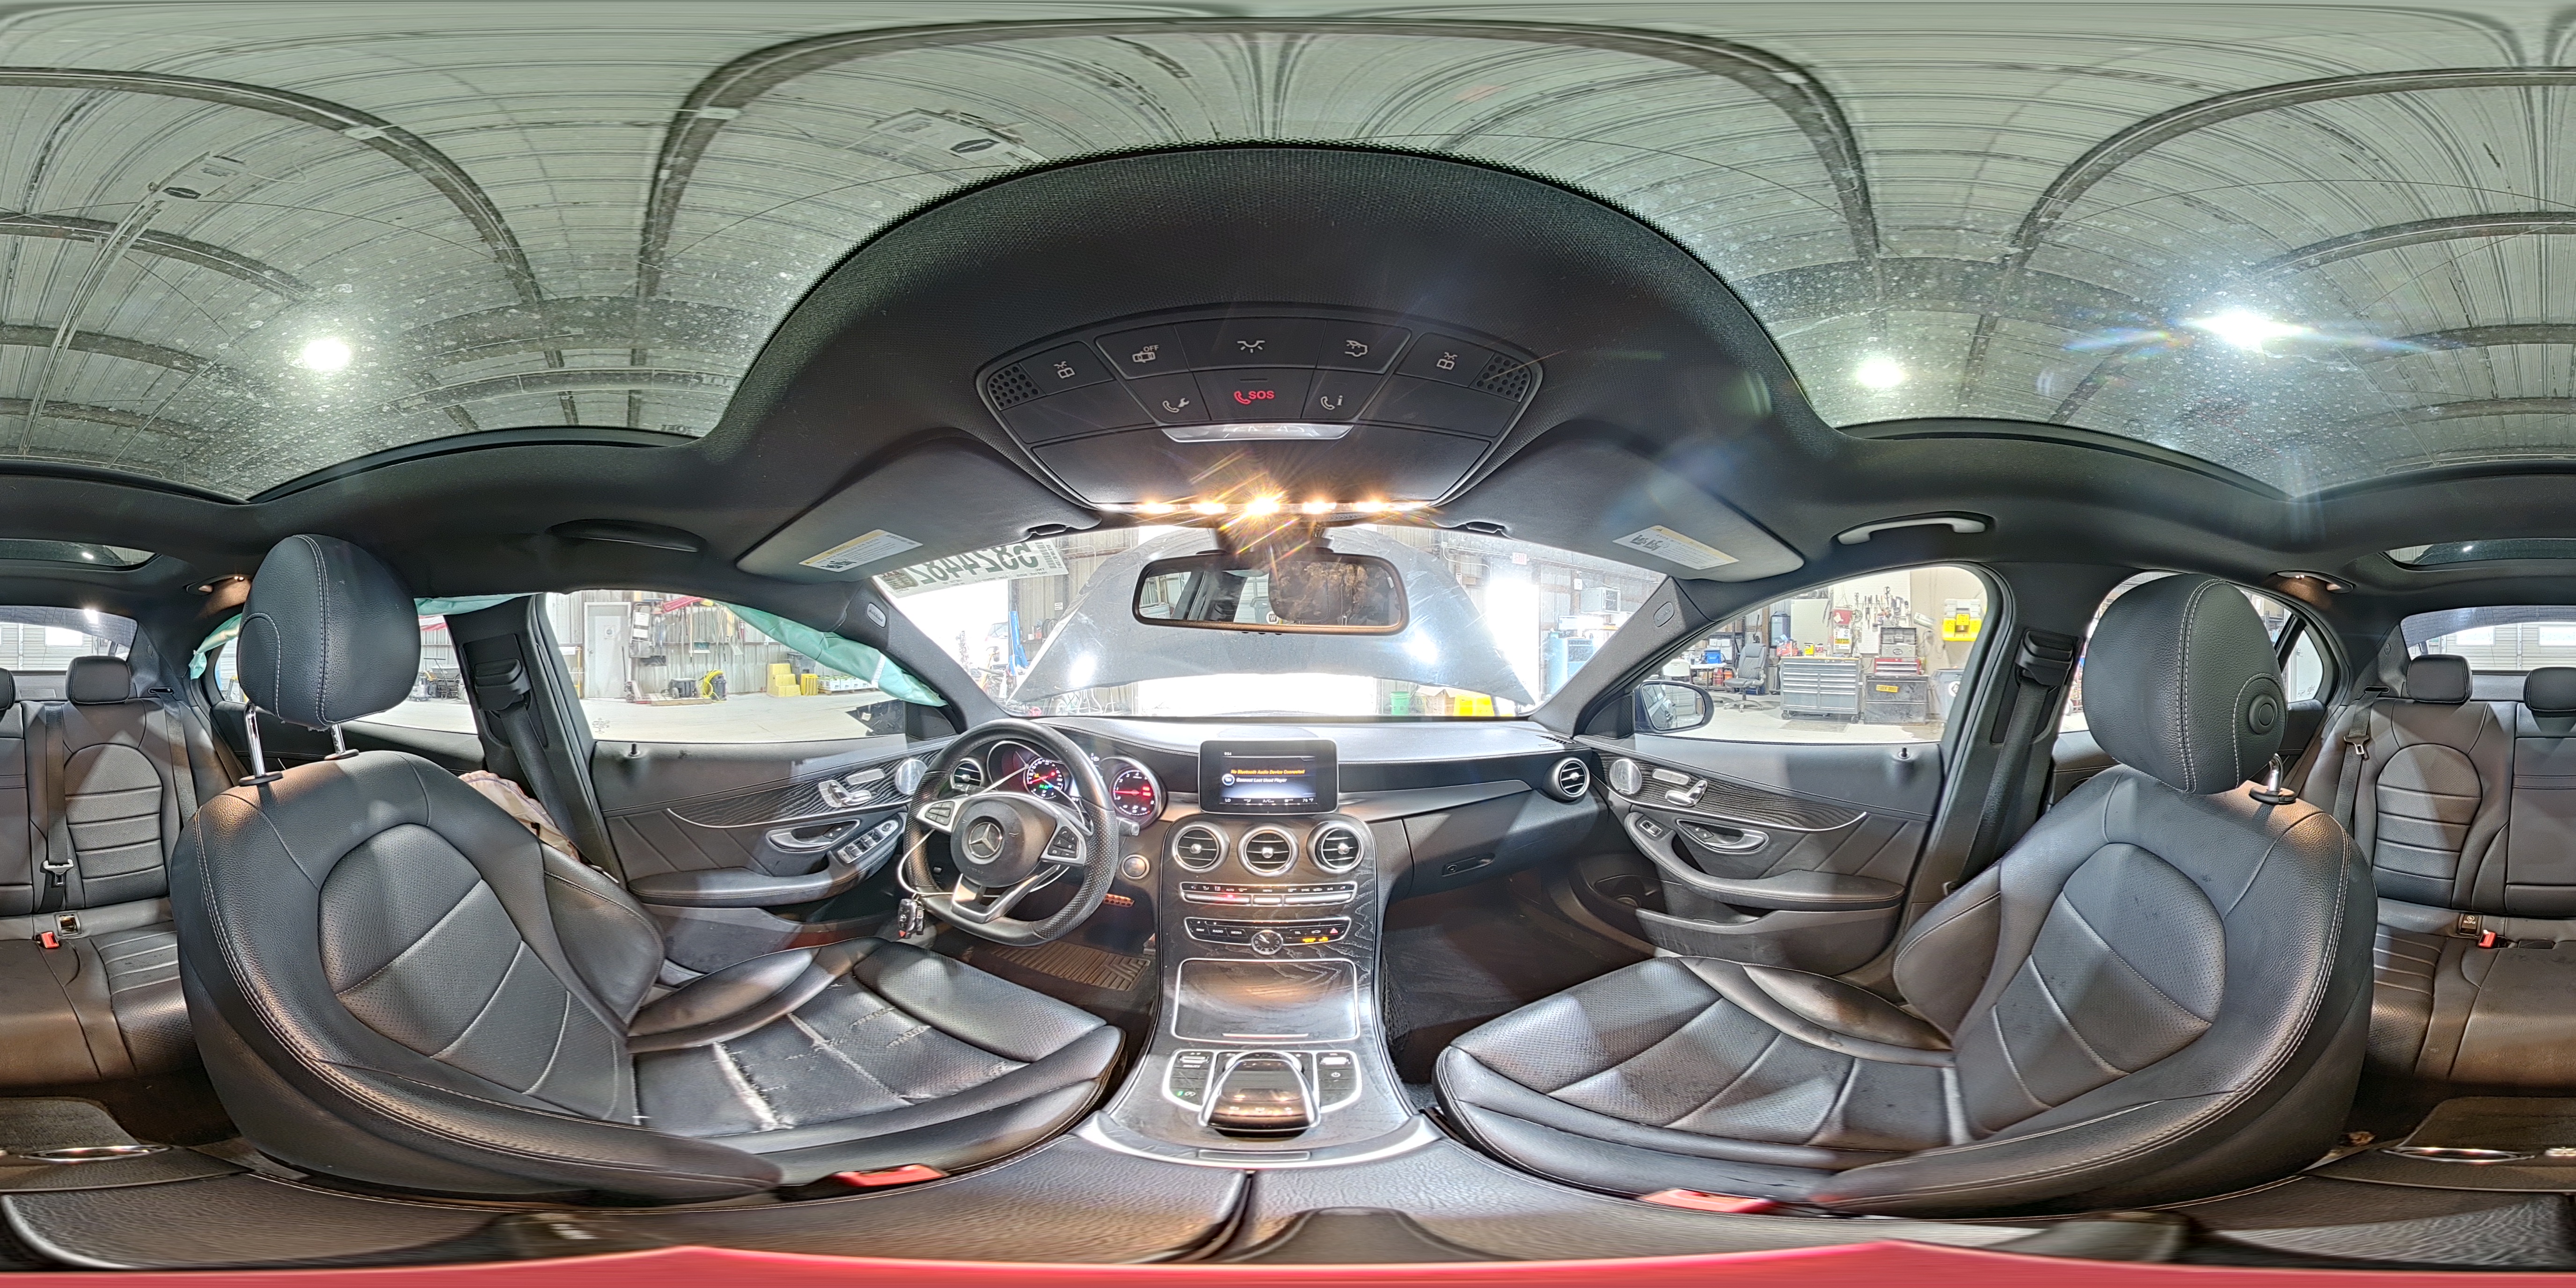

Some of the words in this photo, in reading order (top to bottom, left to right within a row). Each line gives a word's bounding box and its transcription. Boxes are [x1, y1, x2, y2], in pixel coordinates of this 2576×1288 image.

[1248, 390, 1275, 399] SOS
[837, 547, 857, 556] ADVANCED
[869, 609, 883, 622] AIRBAG
